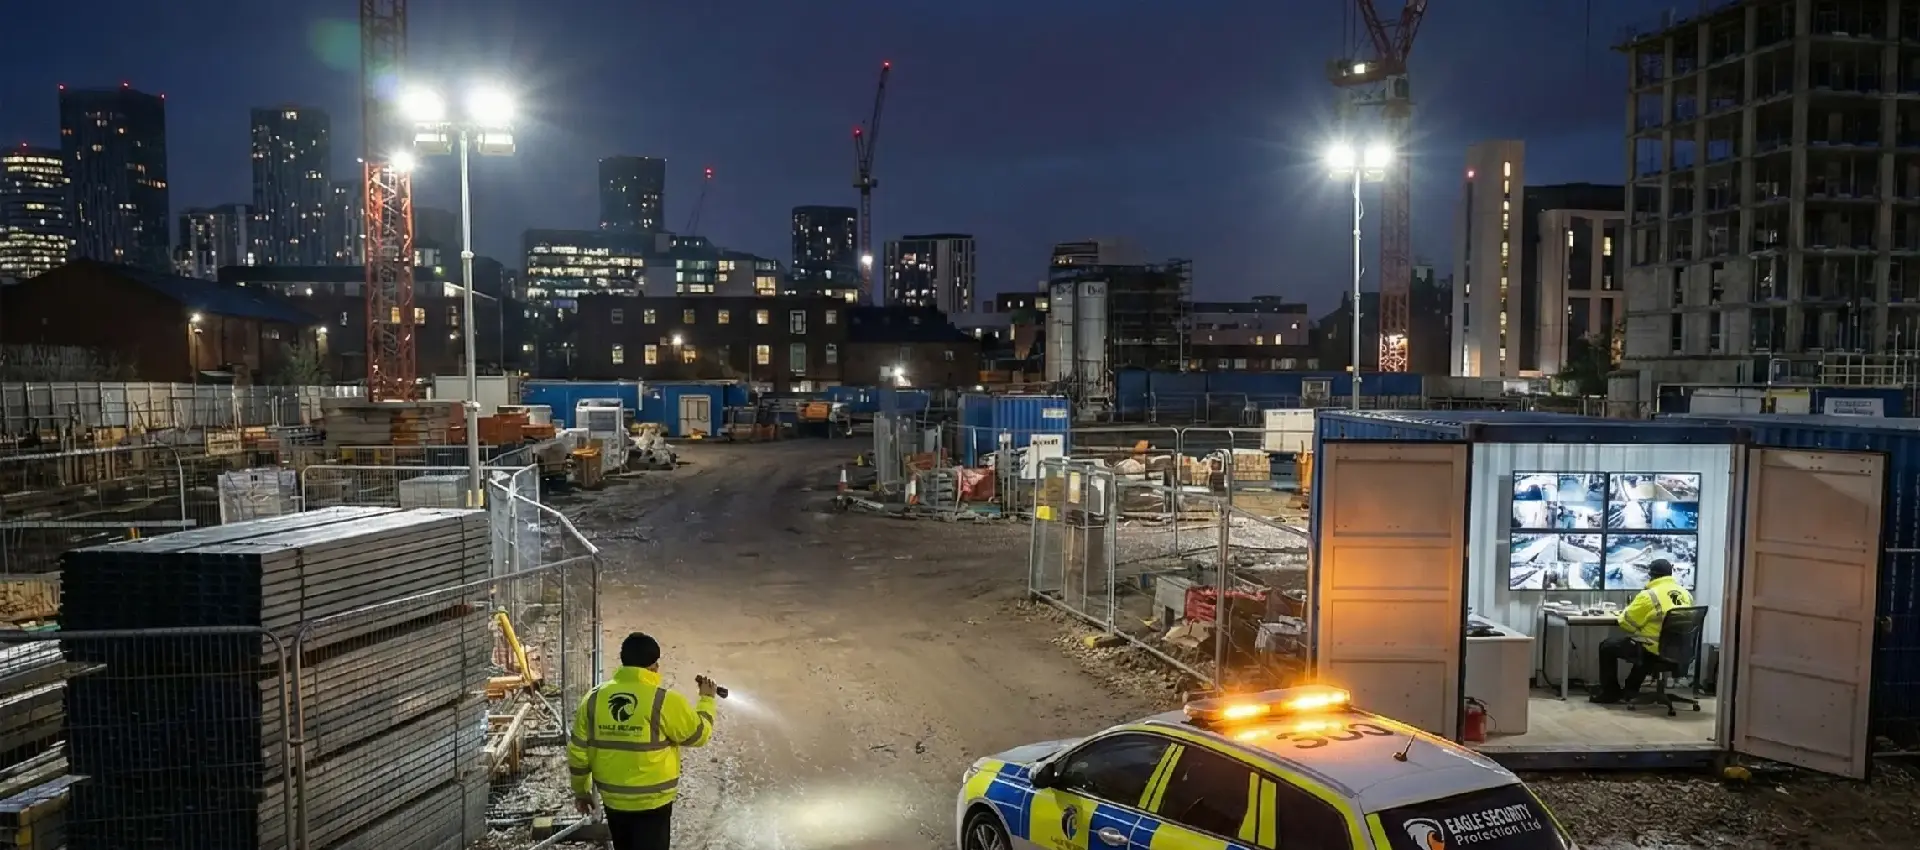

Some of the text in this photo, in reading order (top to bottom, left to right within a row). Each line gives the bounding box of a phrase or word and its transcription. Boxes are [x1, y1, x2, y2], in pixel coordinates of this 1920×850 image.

[1445, 804, 1532, 835] EAGLE SECURITY
[1456, 818, 1542, 846] Protection Ltd
